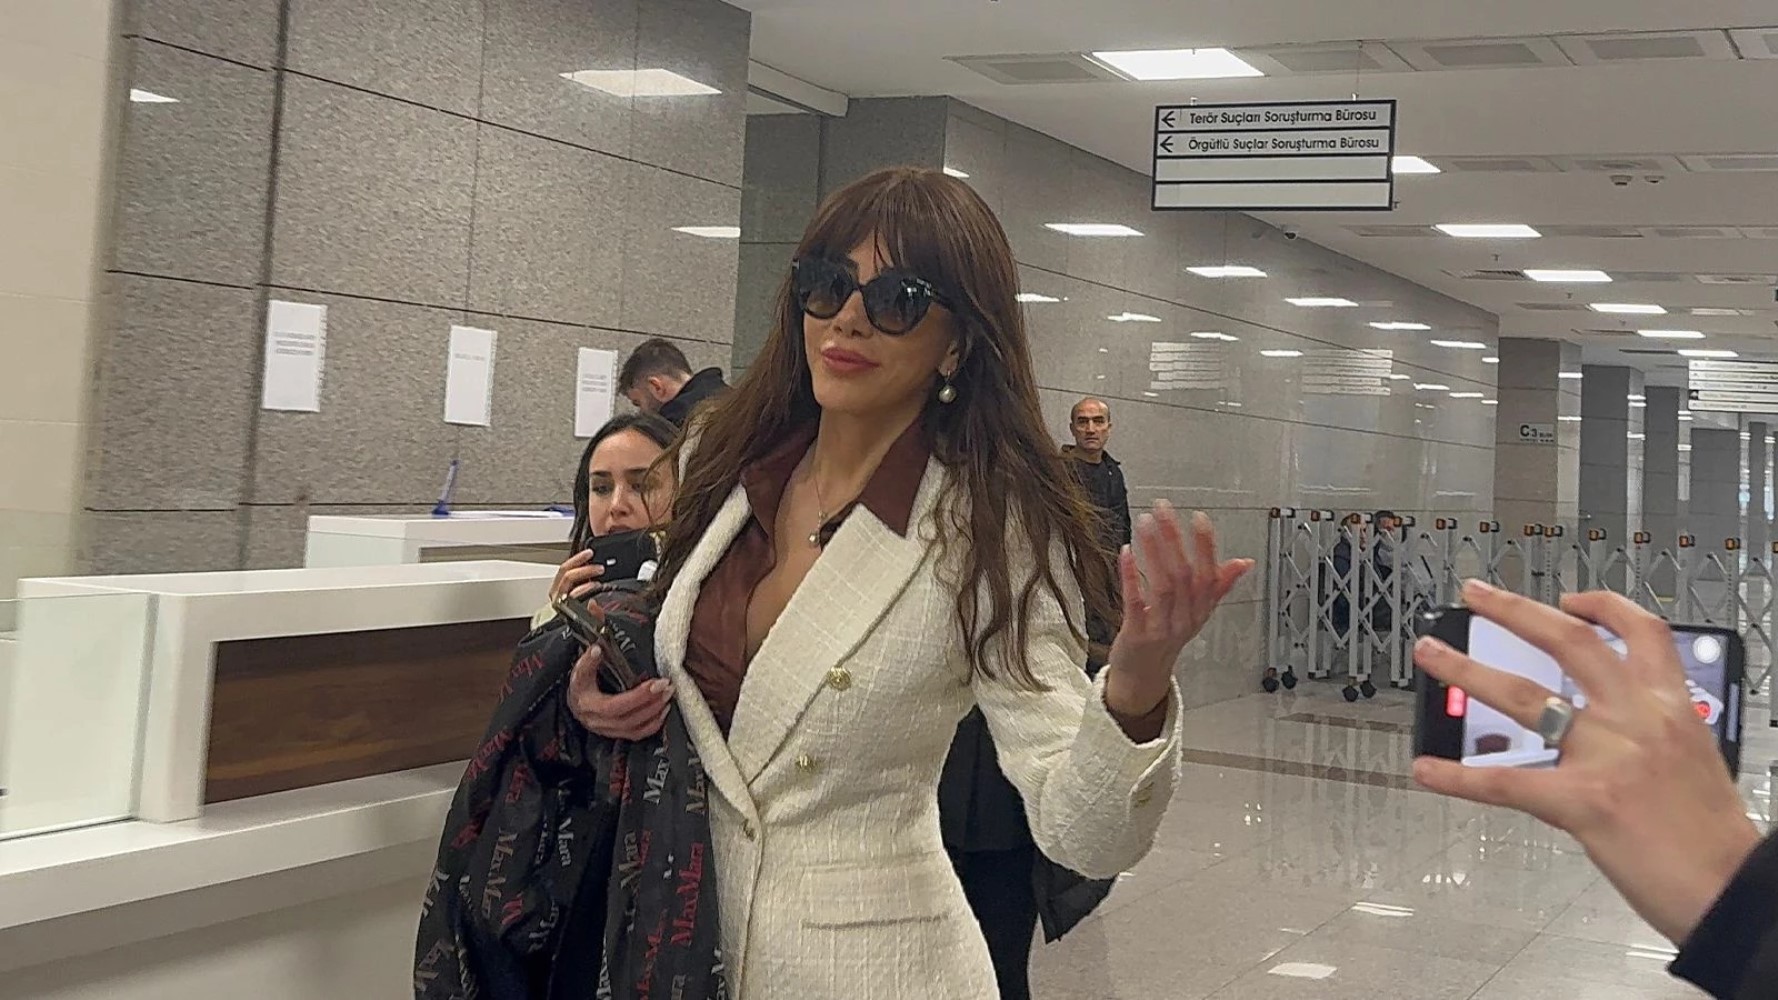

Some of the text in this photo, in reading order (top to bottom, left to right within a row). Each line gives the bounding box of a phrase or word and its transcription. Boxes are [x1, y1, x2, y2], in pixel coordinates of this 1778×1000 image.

[1189, 109, 1376, 126] Terör Suçları Soruşturma Bürosu
[1188, 137, 1379, 152] Örgütlü Suçlar Soruşturma Bürosu
